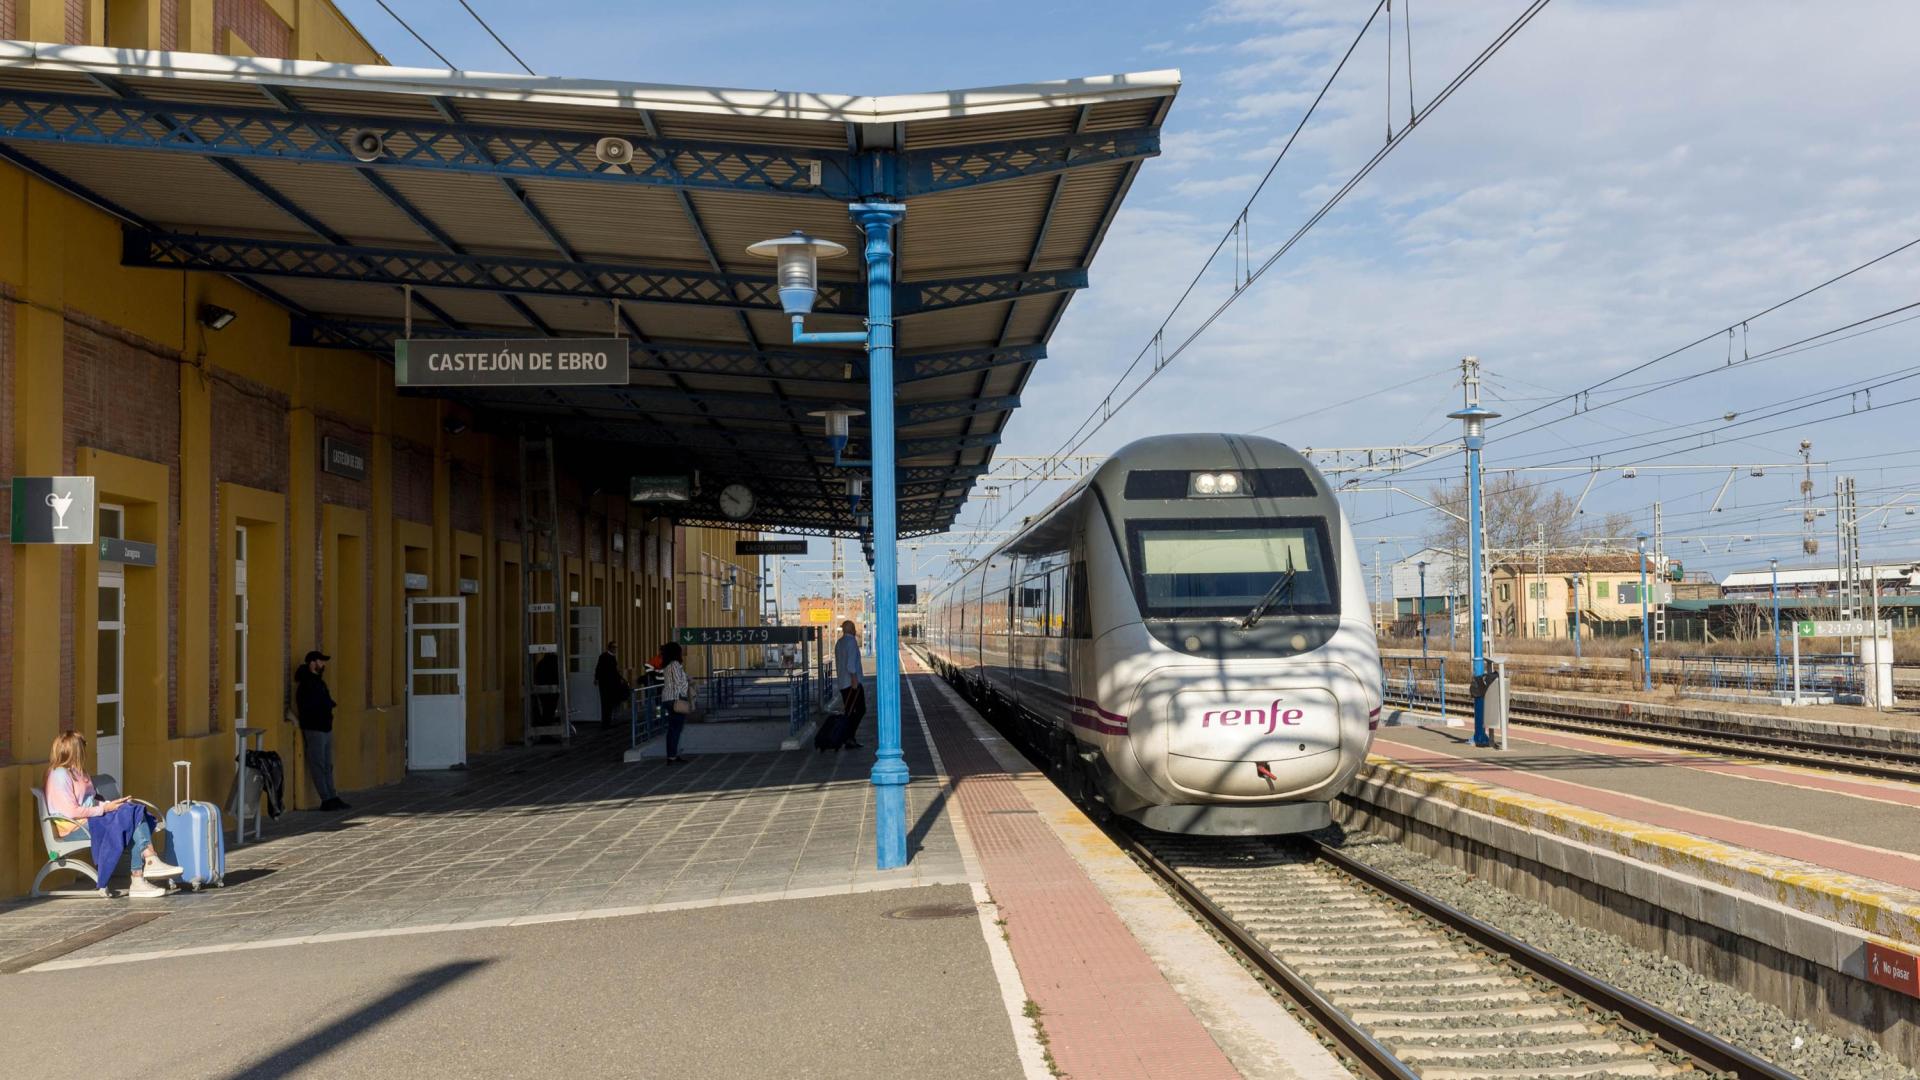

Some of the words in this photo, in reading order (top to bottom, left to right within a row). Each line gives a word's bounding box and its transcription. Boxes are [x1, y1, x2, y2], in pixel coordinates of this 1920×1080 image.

[428, 350, 524, 371] CASTEJÓN
[529, 353, 553, 370] DE
[558, 352, 608, 370] EBRO
[1619, 593, 1626, 604] 3
[1664, 592, 1671, 604] 5
[1202, 698, 1304, 735] renfe
[1882, 960, 1892, 975] No
[1892, 966, 1910, 981] pasar
